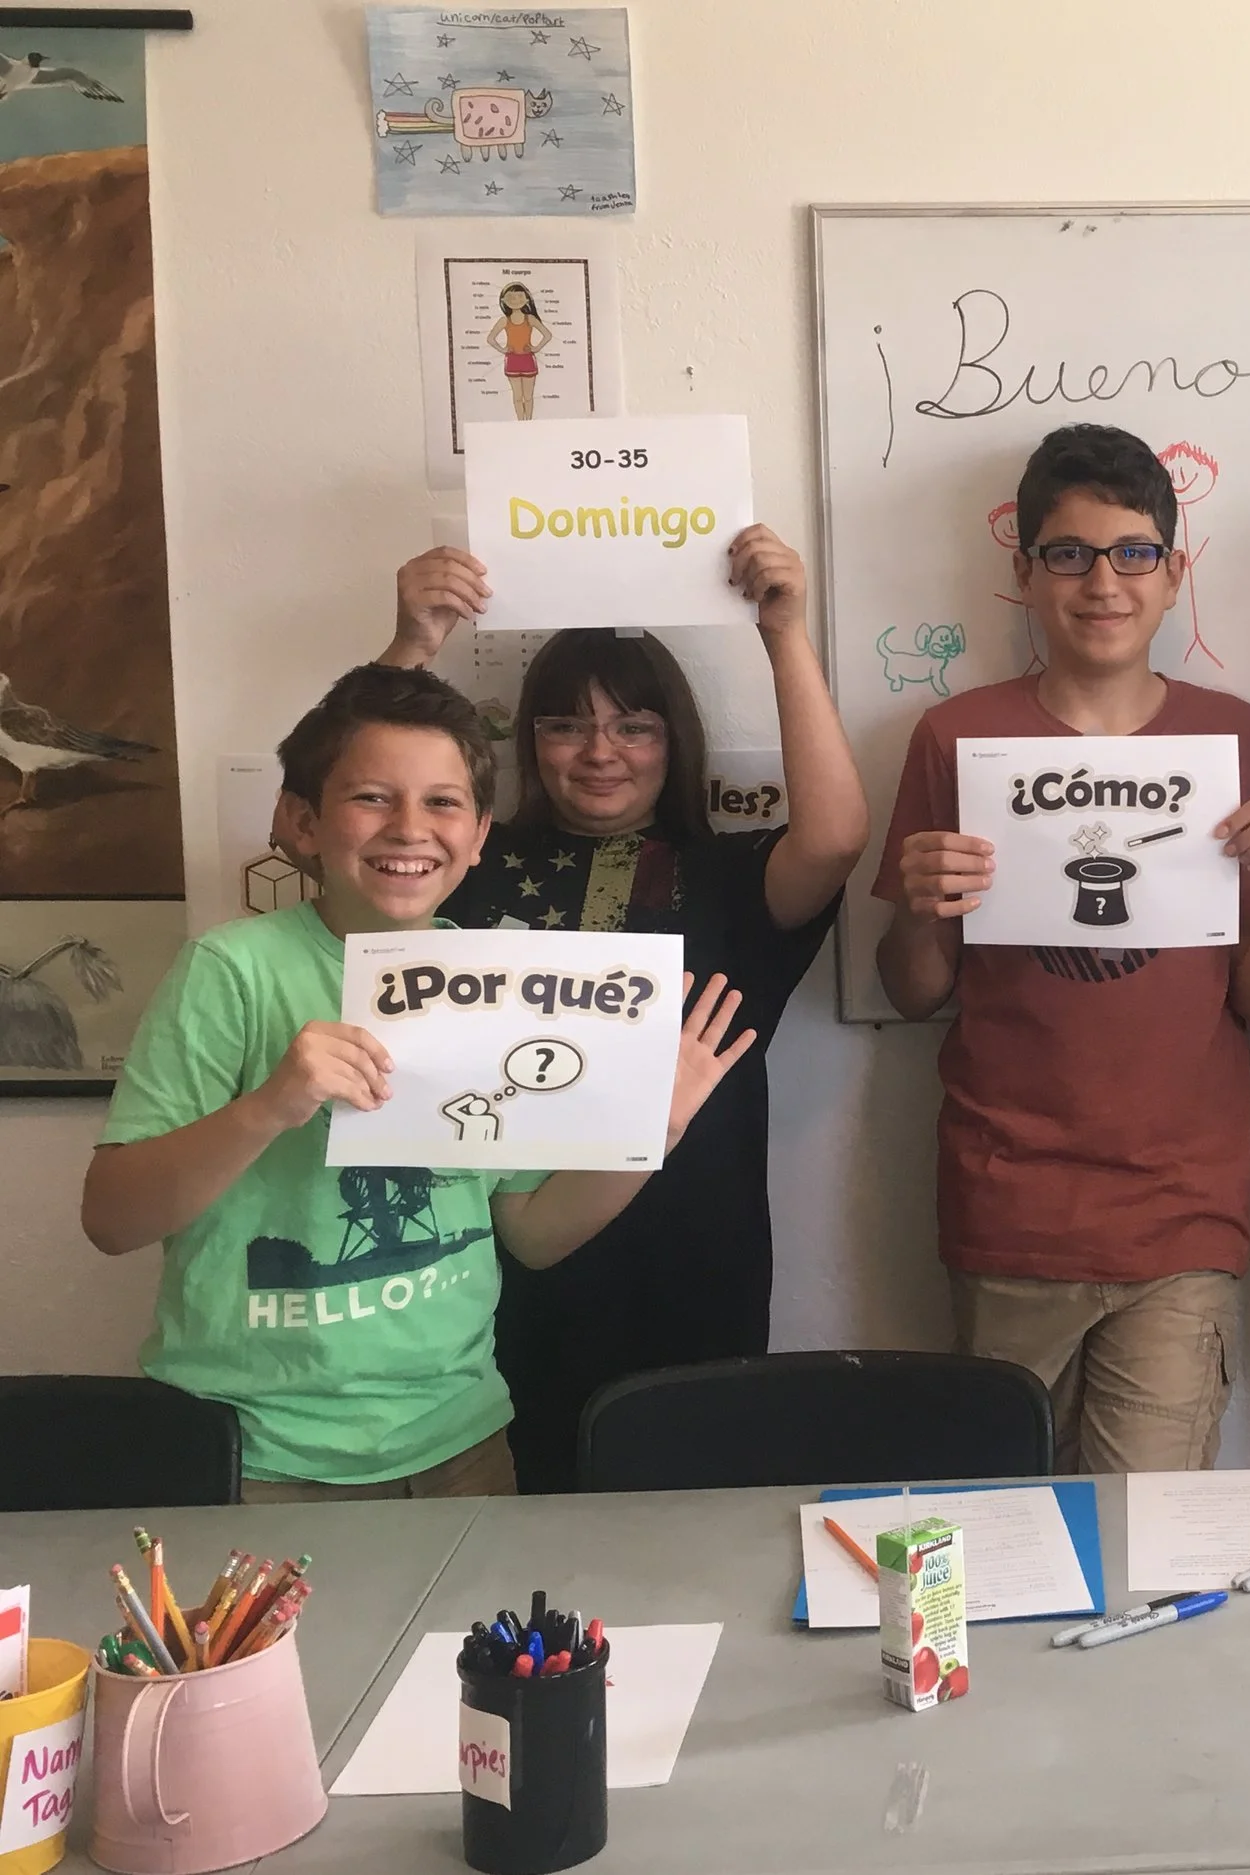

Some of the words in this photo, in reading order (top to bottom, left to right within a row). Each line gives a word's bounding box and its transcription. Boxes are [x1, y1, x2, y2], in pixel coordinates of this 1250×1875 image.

[570, 448, 649, 470] 30-35
[509, 496, 716, 549] Domingo
[709, 779, 781, 818] les?
[1011, 768, 1191, 816] ¿Cómo?
[377, 965, 506, 1016] ¿Por
[521, 970, 654, 1019] qué?
[918, 1533, 952, 1552] KIRKLAND
[22, 1734, 82, 1784] Nam
[460, 1740, 506, 1784] rpies
